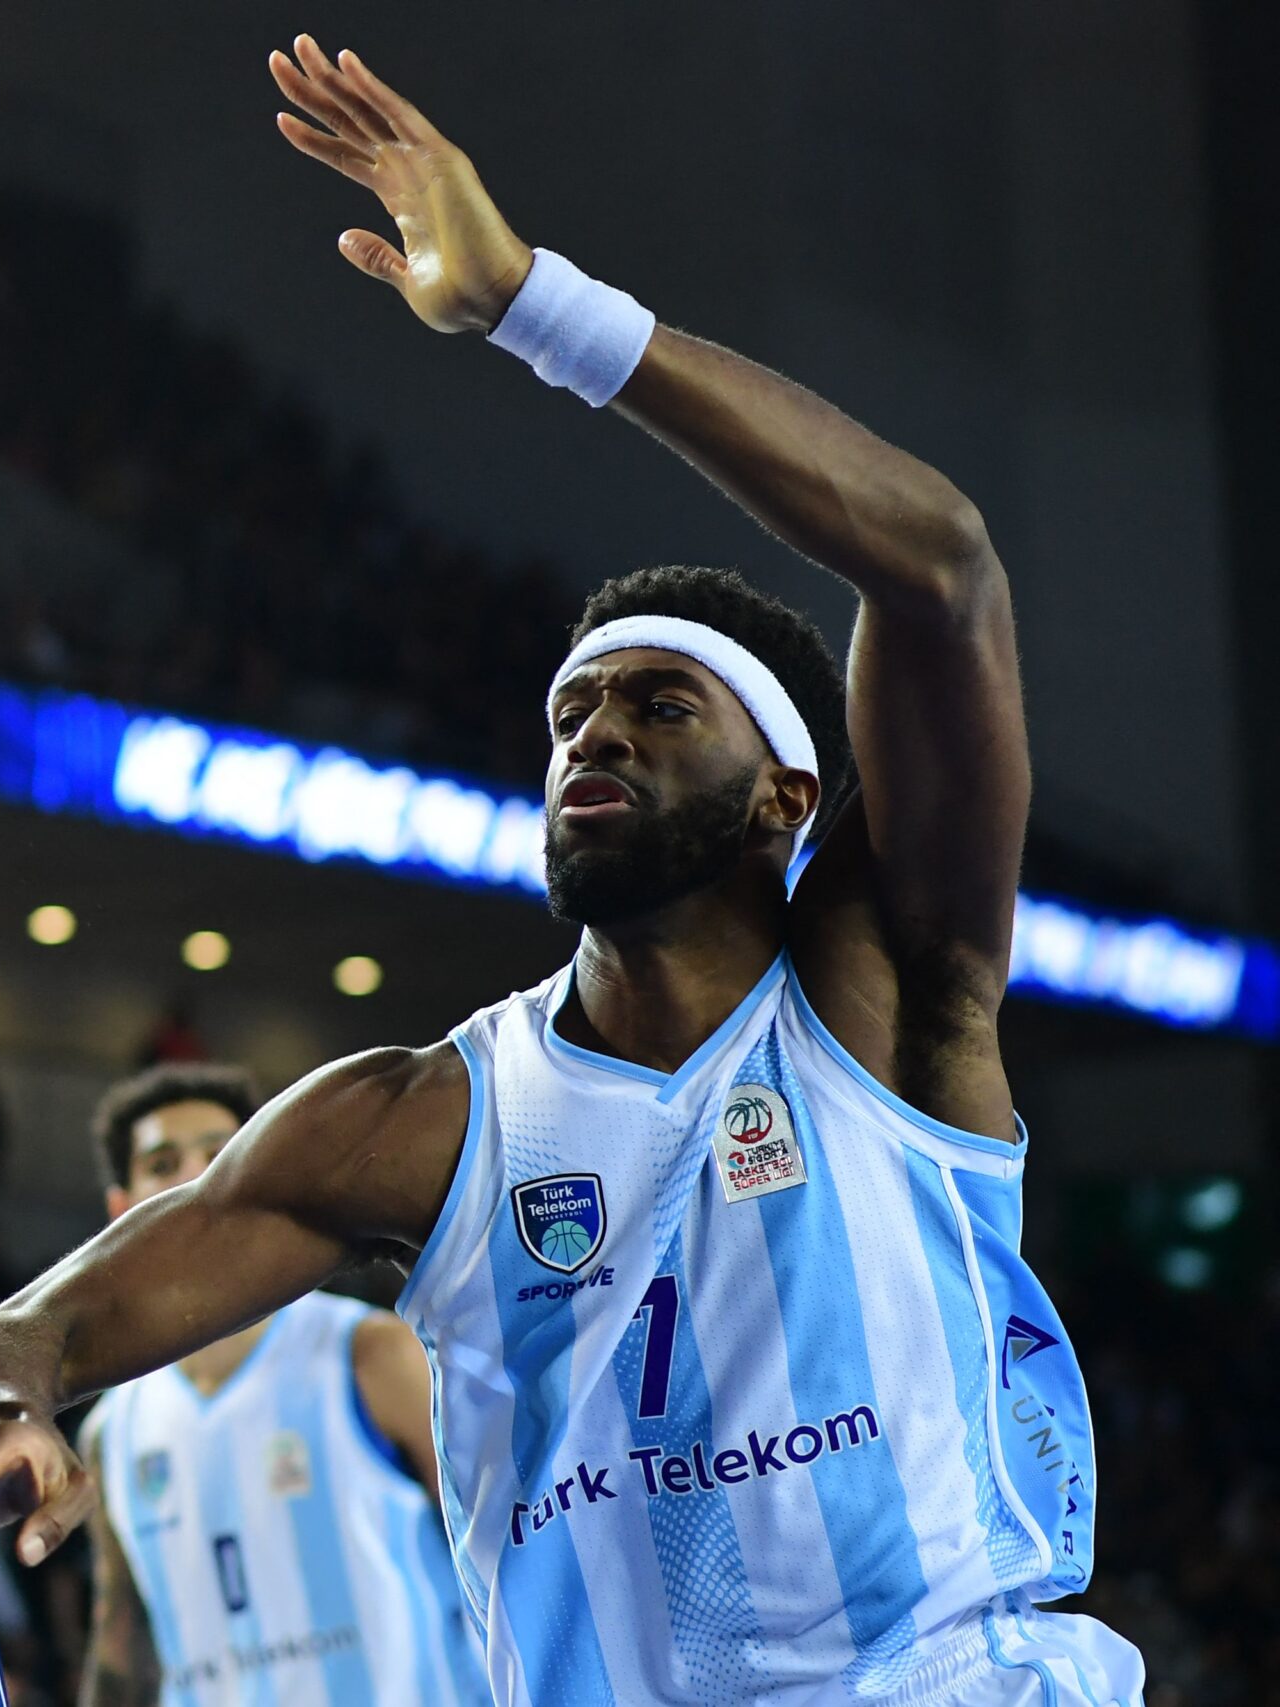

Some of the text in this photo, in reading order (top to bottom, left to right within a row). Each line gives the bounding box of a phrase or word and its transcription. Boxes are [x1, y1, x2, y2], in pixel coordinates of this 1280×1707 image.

[540, 1185, 574, 1201] Türk
[527, 1198, 592, 1217] Telekom
[628, 1404, 880, 1497] Telekom
